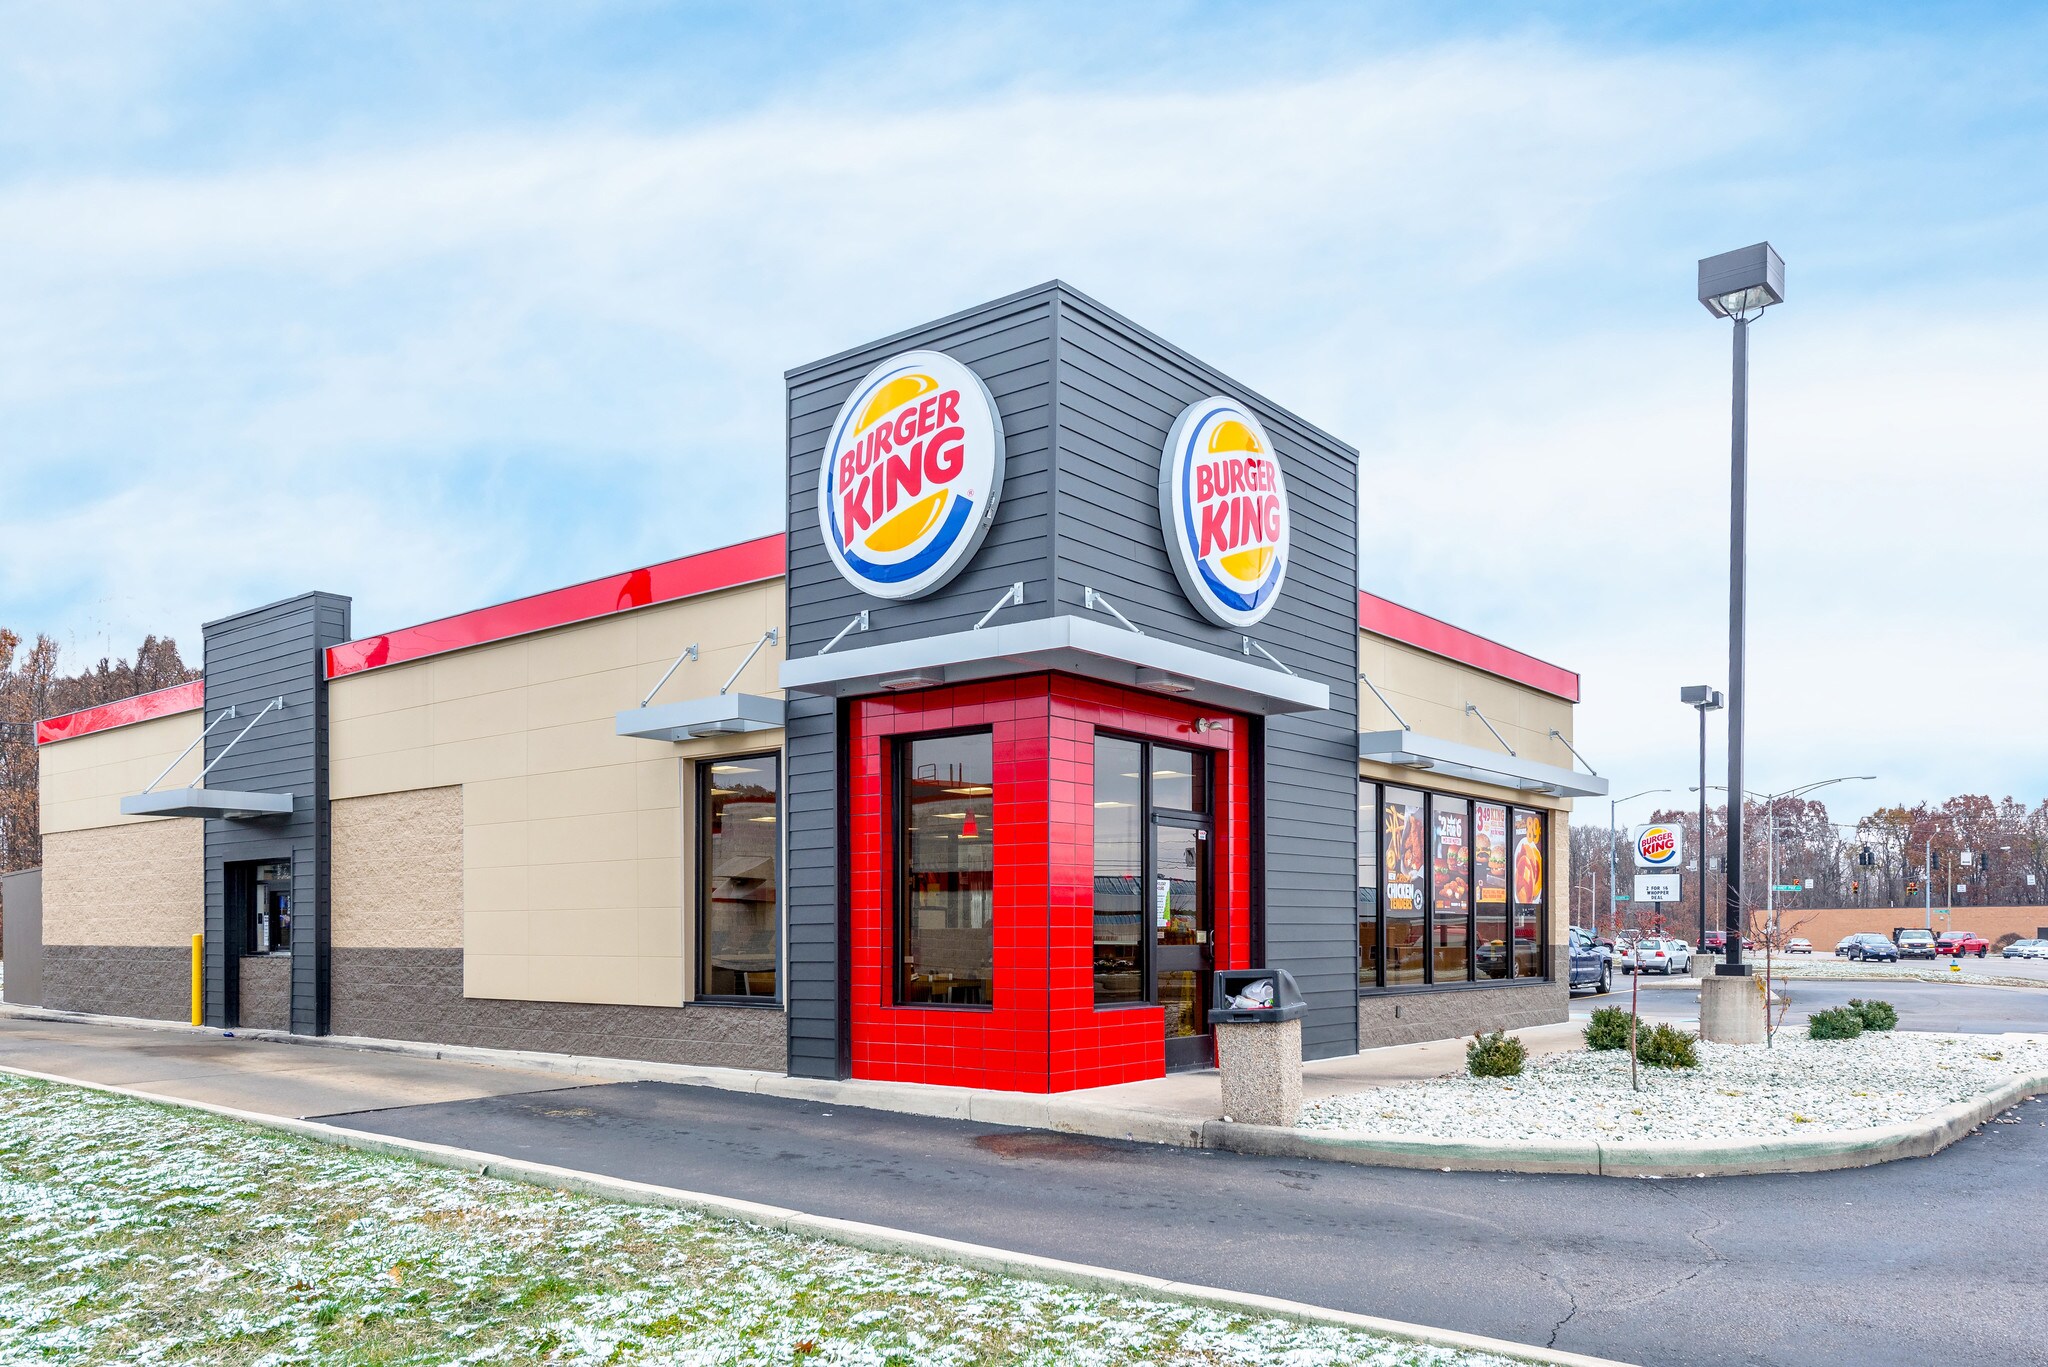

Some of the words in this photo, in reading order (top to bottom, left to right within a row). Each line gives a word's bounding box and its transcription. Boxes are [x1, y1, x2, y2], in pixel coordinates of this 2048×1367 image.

[839, 389, 960, 496] BURGER
[843, 426, 965, 549] KING
[1196, 457, 1277, 504] BURGER
[1199, 494, 1280, 559] KING
[1641, 832, 1673, 848] BURGER
[1643, 839, 1674, 857] KING
[1387, 882, 1415, 899] CHICKEN
